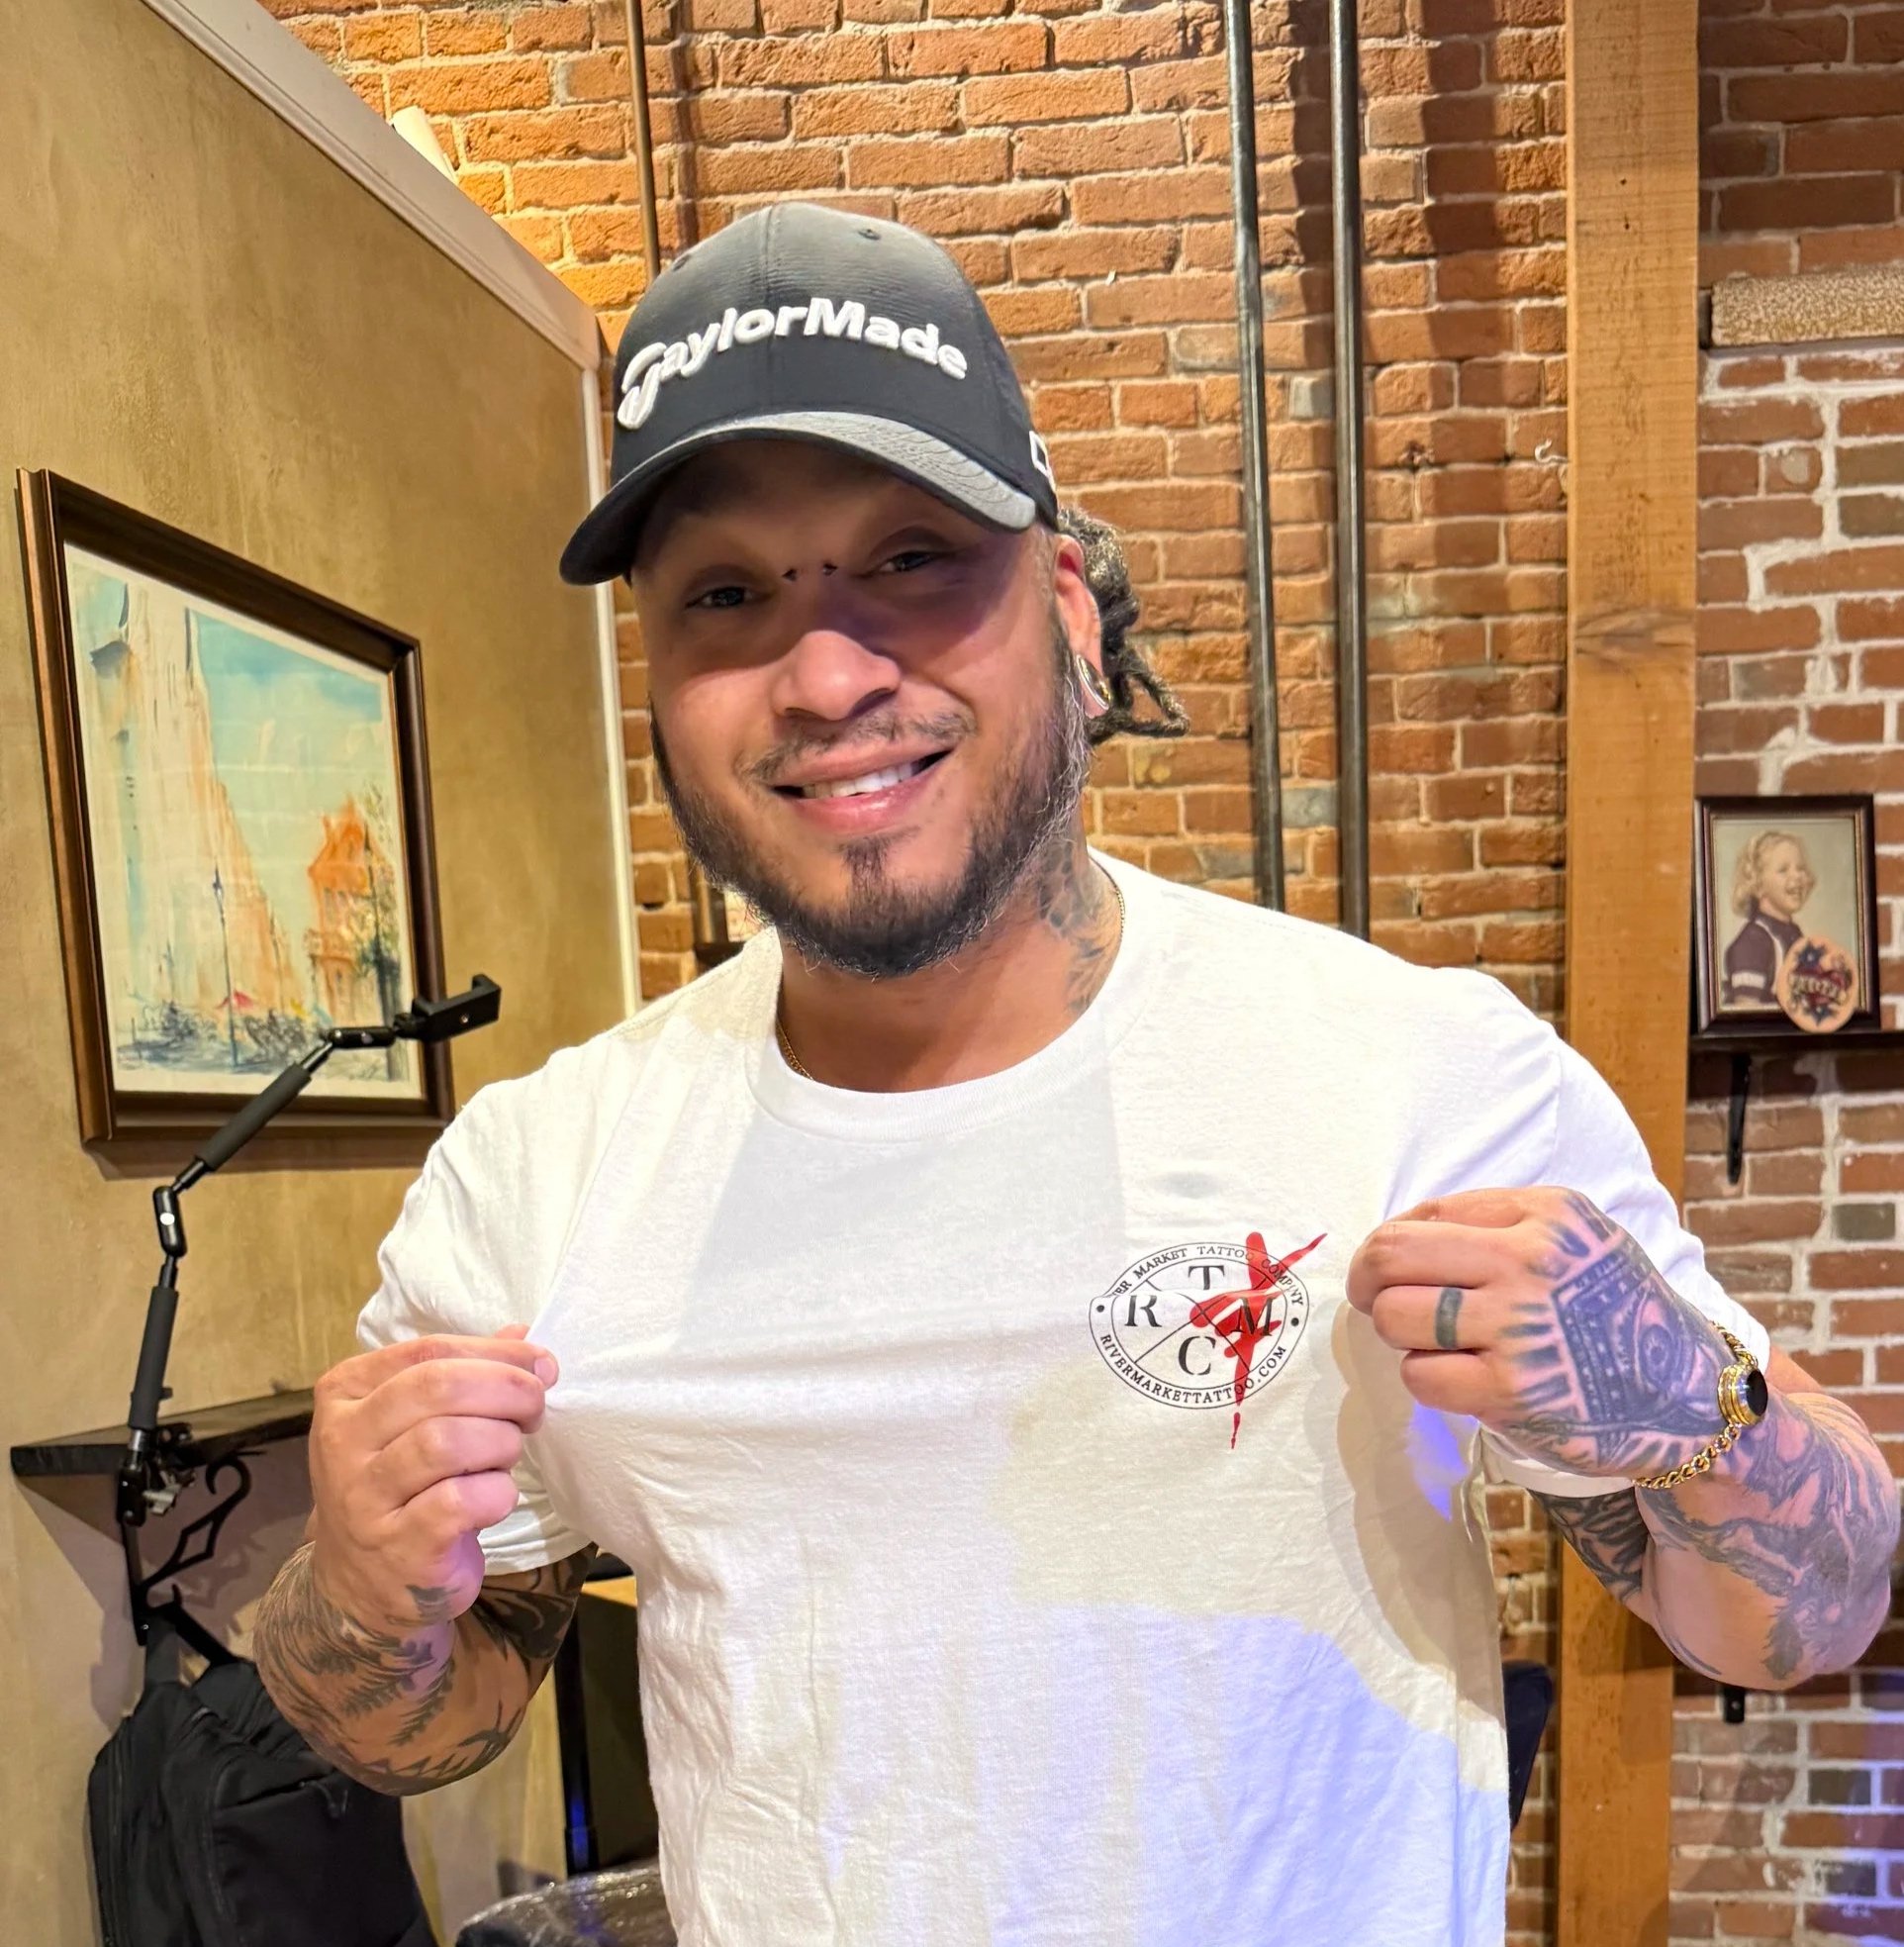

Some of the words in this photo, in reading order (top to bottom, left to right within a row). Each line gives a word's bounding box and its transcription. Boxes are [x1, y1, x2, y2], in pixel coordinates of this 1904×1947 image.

[618, 297, 968, 430] TaylorMade
[1133, 1248, 1188, 1279] MARKET
[1196, 1245, 1255, 1261] TATTOO
[1188, 1265, 1225, 1291] T
[1100, 1333, 1286, 1404] RIVERMARKETTATTOO.COM
[1179, 1336, 1216, 1375] C
